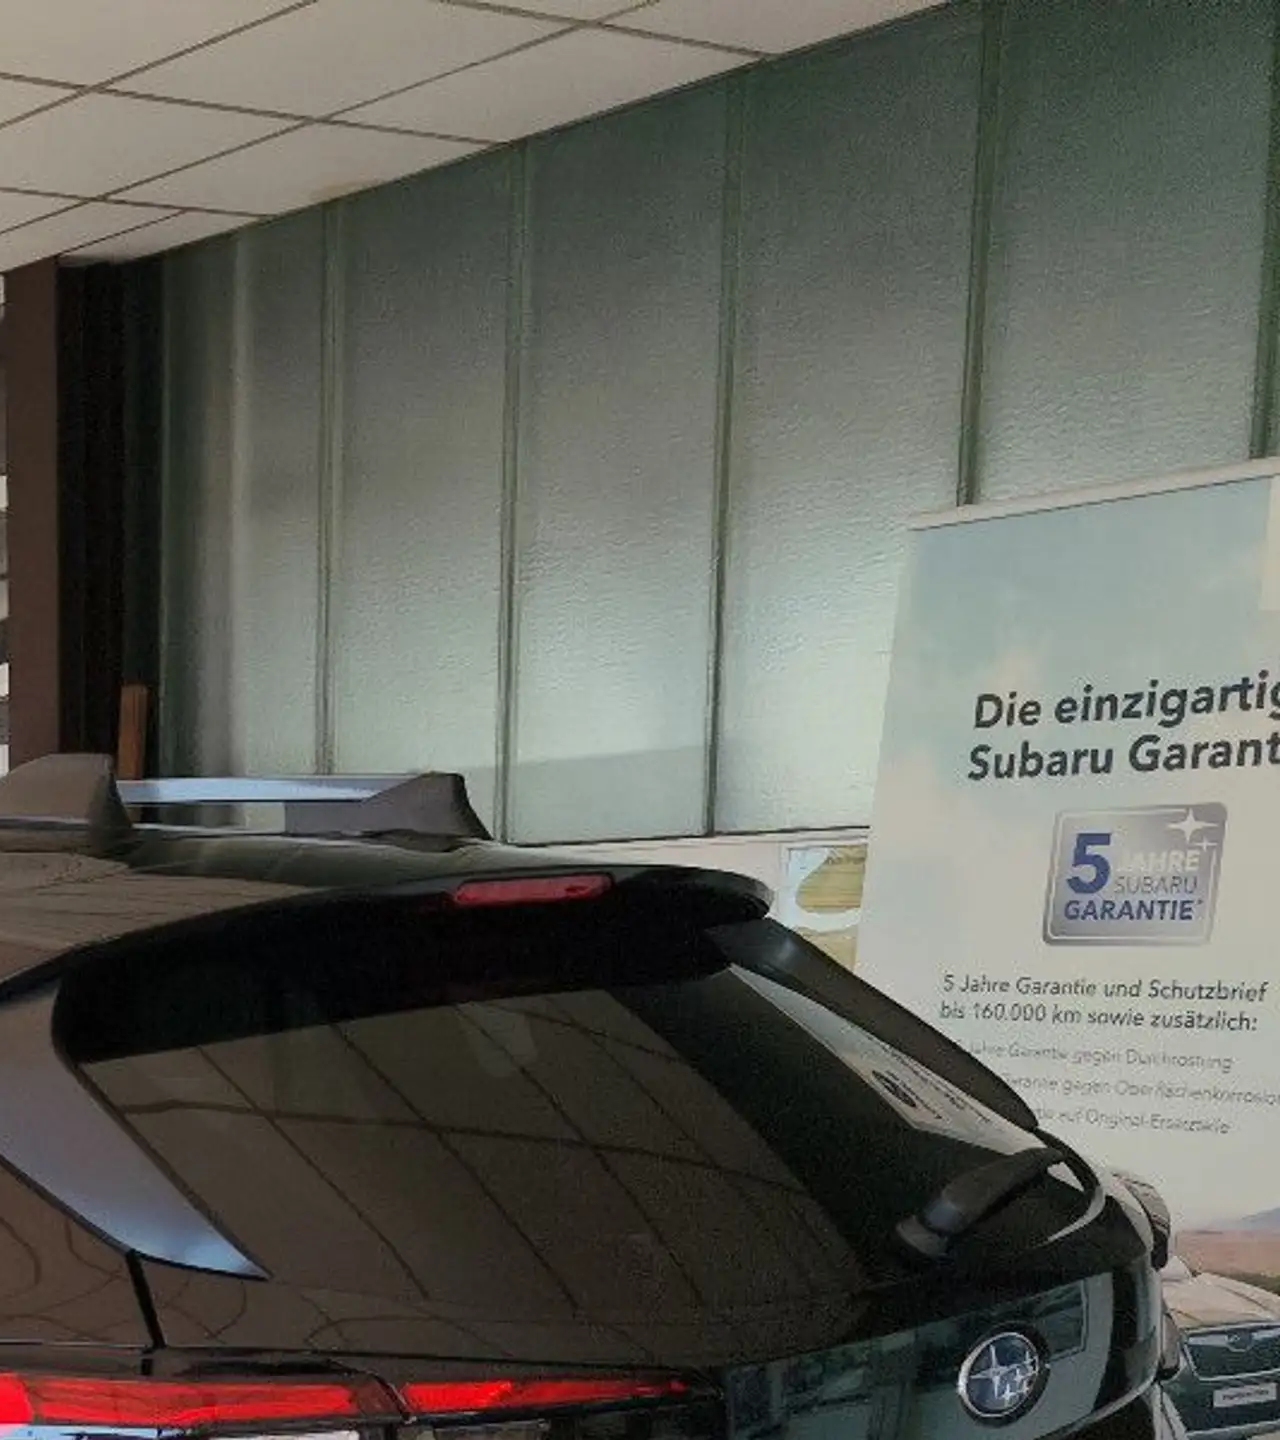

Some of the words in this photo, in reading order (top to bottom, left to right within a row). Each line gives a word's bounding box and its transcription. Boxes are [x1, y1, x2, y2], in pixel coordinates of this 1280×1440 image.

[974, 690, 1041, 729] Die
[967, 740, 1114, 782] Subaru
[1066, 832, 1112, 895] 5
[1115, 849, 1202, 872] JAHRE
[1113, 876, 1198, 895] SUBARU
[943, 973, 955, 993] 5
[959, 974, 1011, 994] Jahre
[1015, 976, 1097, 998] Garantie
[1103, 979, 1142, 999] und
[1147, 979, 1270, 1003] Schutzbrief
[940, 1001, 965, 1021] bis
[973, 1001, 1047, 1023] 160.000
[1051, 1004, 1082, 1025] km
[1087, 1006, 1145, 1029] sowie
[1150, 1008, 1258, 1032] zusätzlich:
